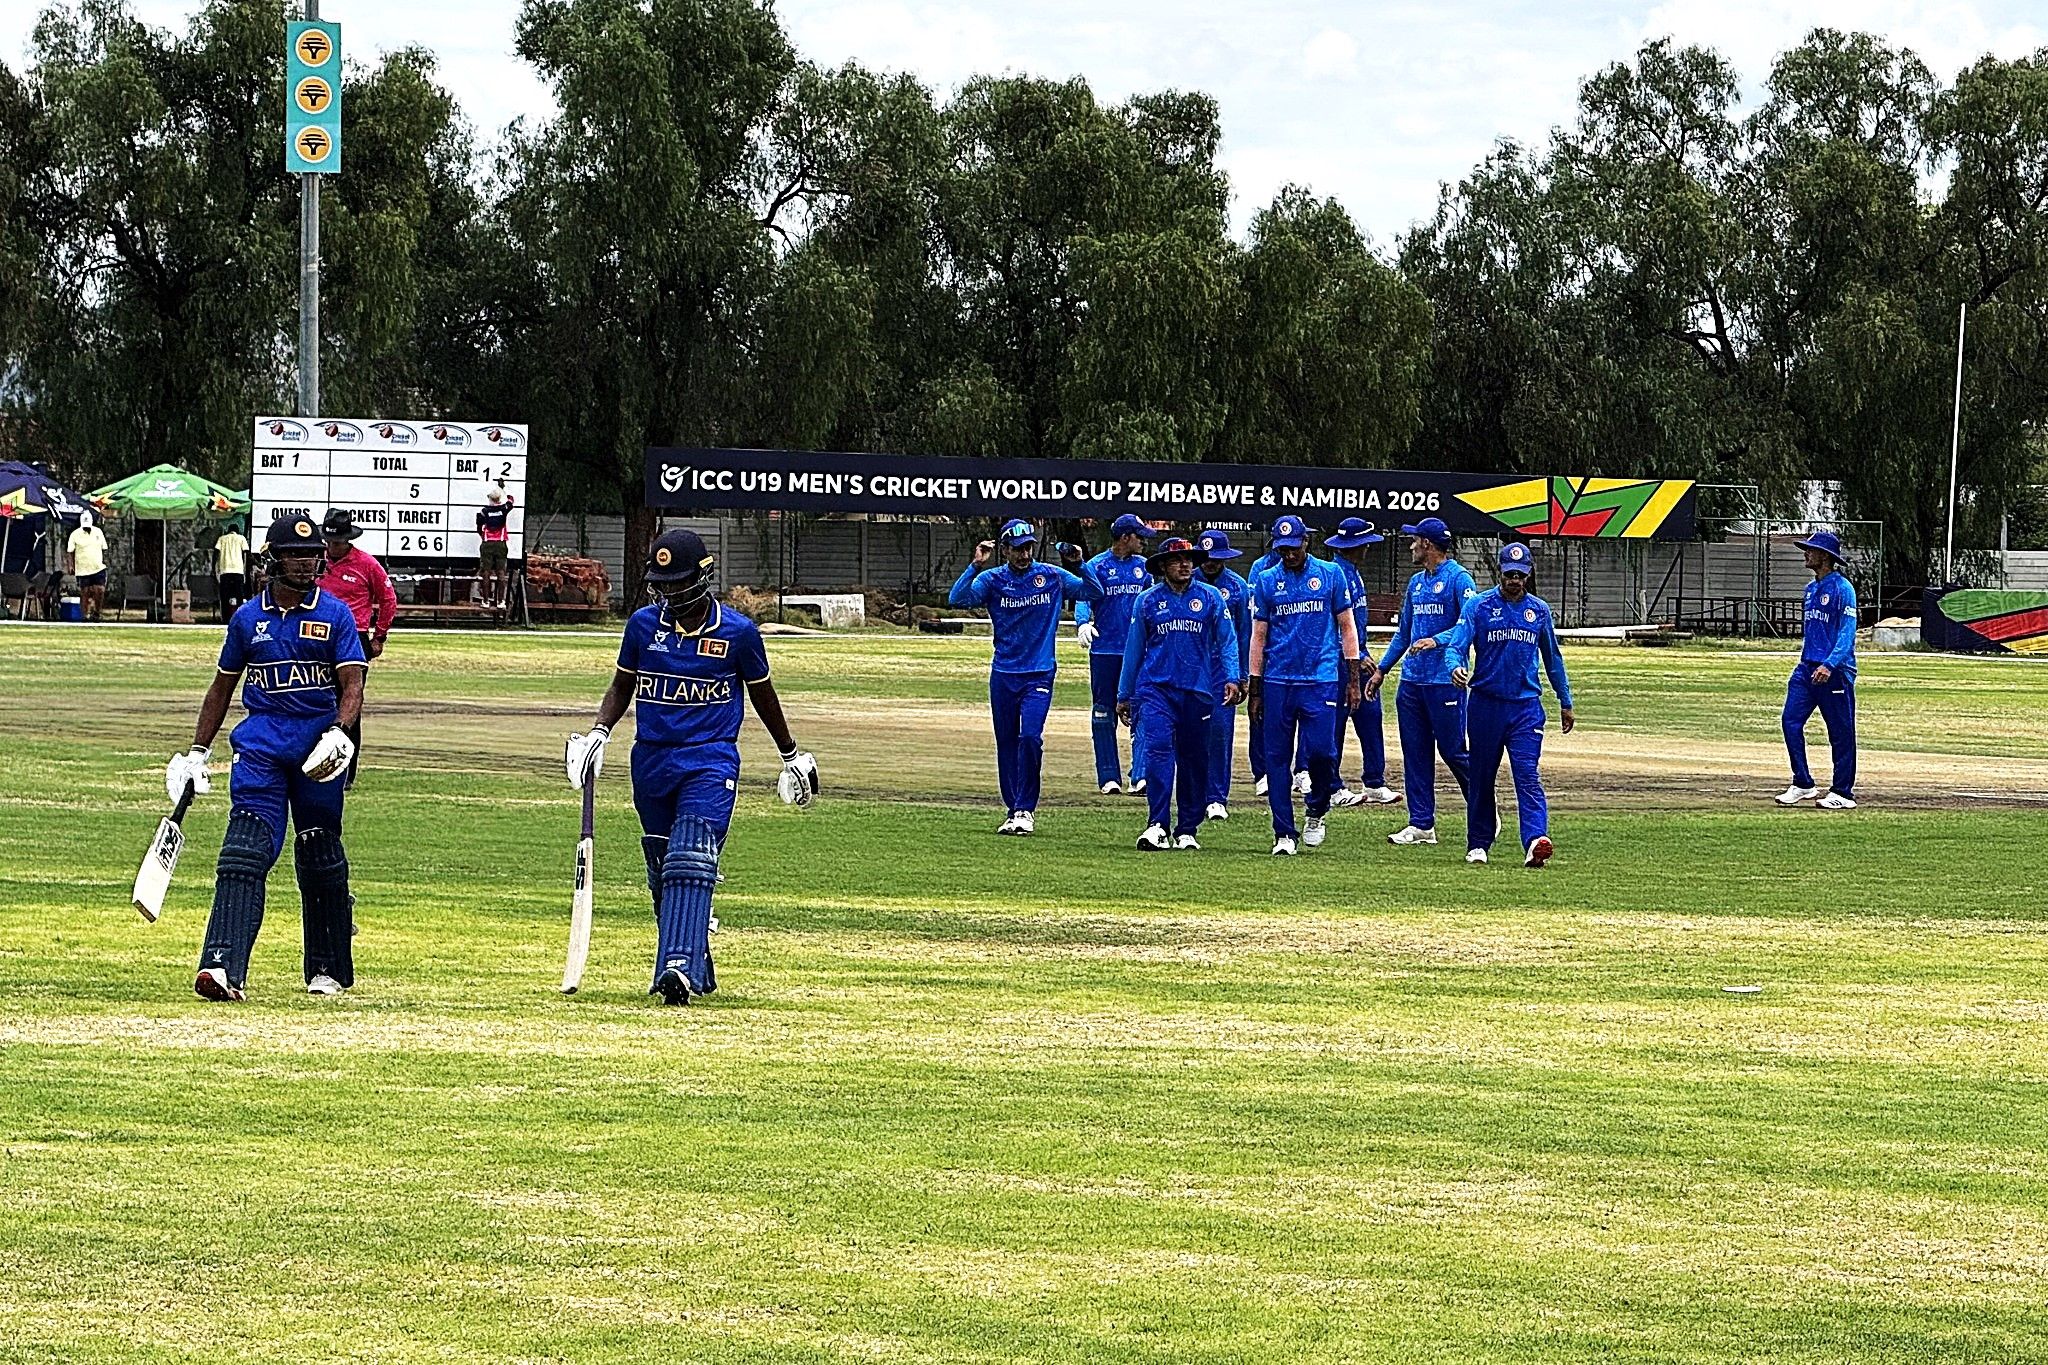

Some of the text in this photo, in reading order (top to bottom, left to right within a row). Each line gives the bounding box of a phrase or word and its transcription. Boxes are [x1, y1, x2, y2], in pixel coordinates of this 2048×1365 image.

[262, 453, 299, 467] BAT 1
[373, 457, 408, 471] TOTAL
[457, 460, 478, 472] BAT
[501, 462, 511, 476] 2
[410, 484, 419, 498] 5
[693, 470, 1439, 510] ICC U19 MEN'S CRICKET WORLD CUP ZIMBABWE & NAMIBIA 2026
[398, 511, 441, 524] TARGET
[662, 680, 730, 701] LANKA
